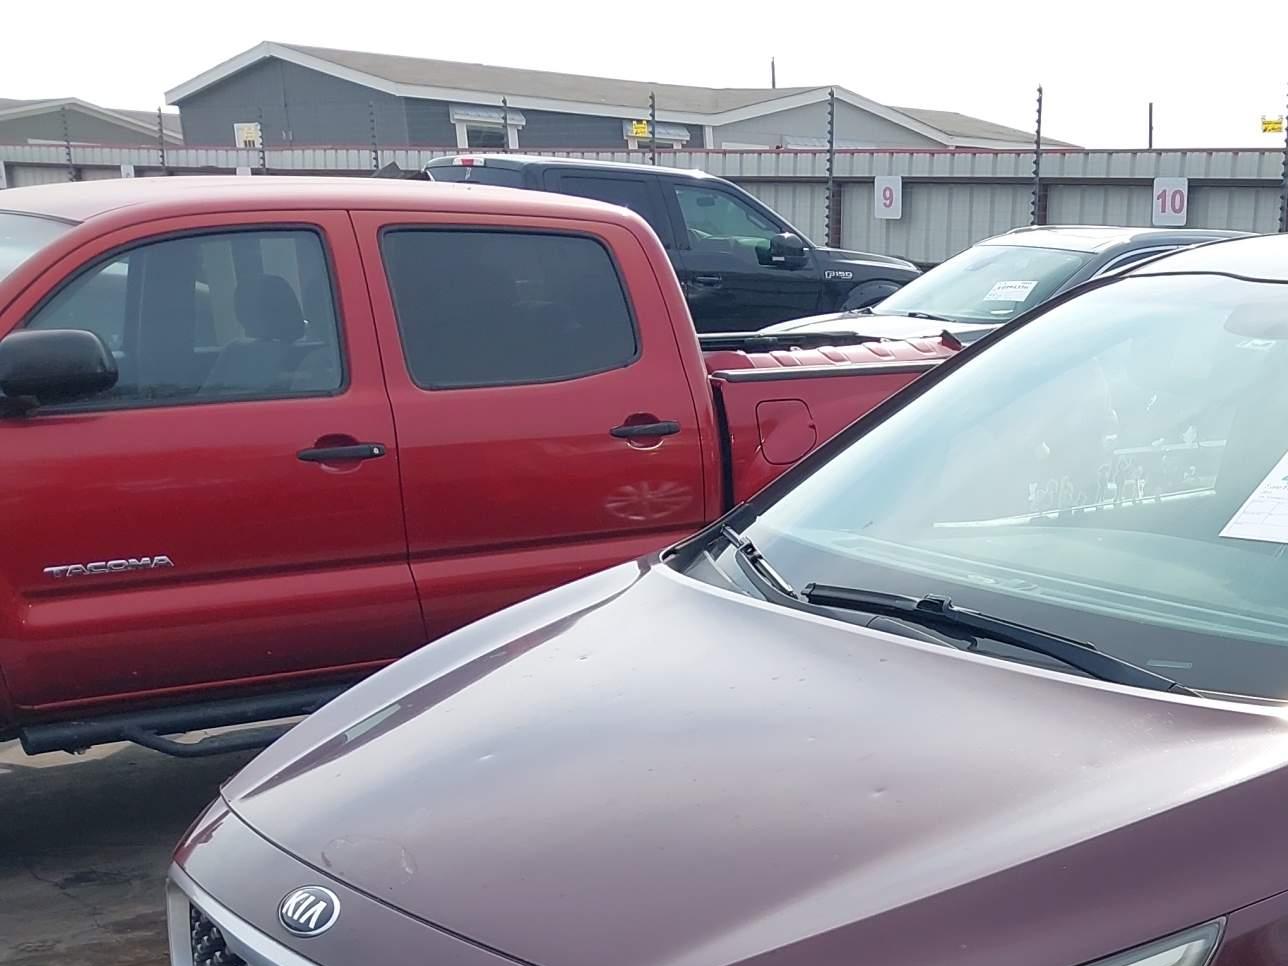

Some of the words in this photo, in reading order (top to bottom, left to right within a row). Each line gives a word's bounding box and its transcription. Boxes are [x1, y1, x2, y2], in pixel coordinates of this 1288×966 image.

[881, 185, 894, 209] 9
[1156, 189, 1185, 215] 10
[43, 555, 175, 578] TACOMA
[281, 889, 328, 930] KIA
